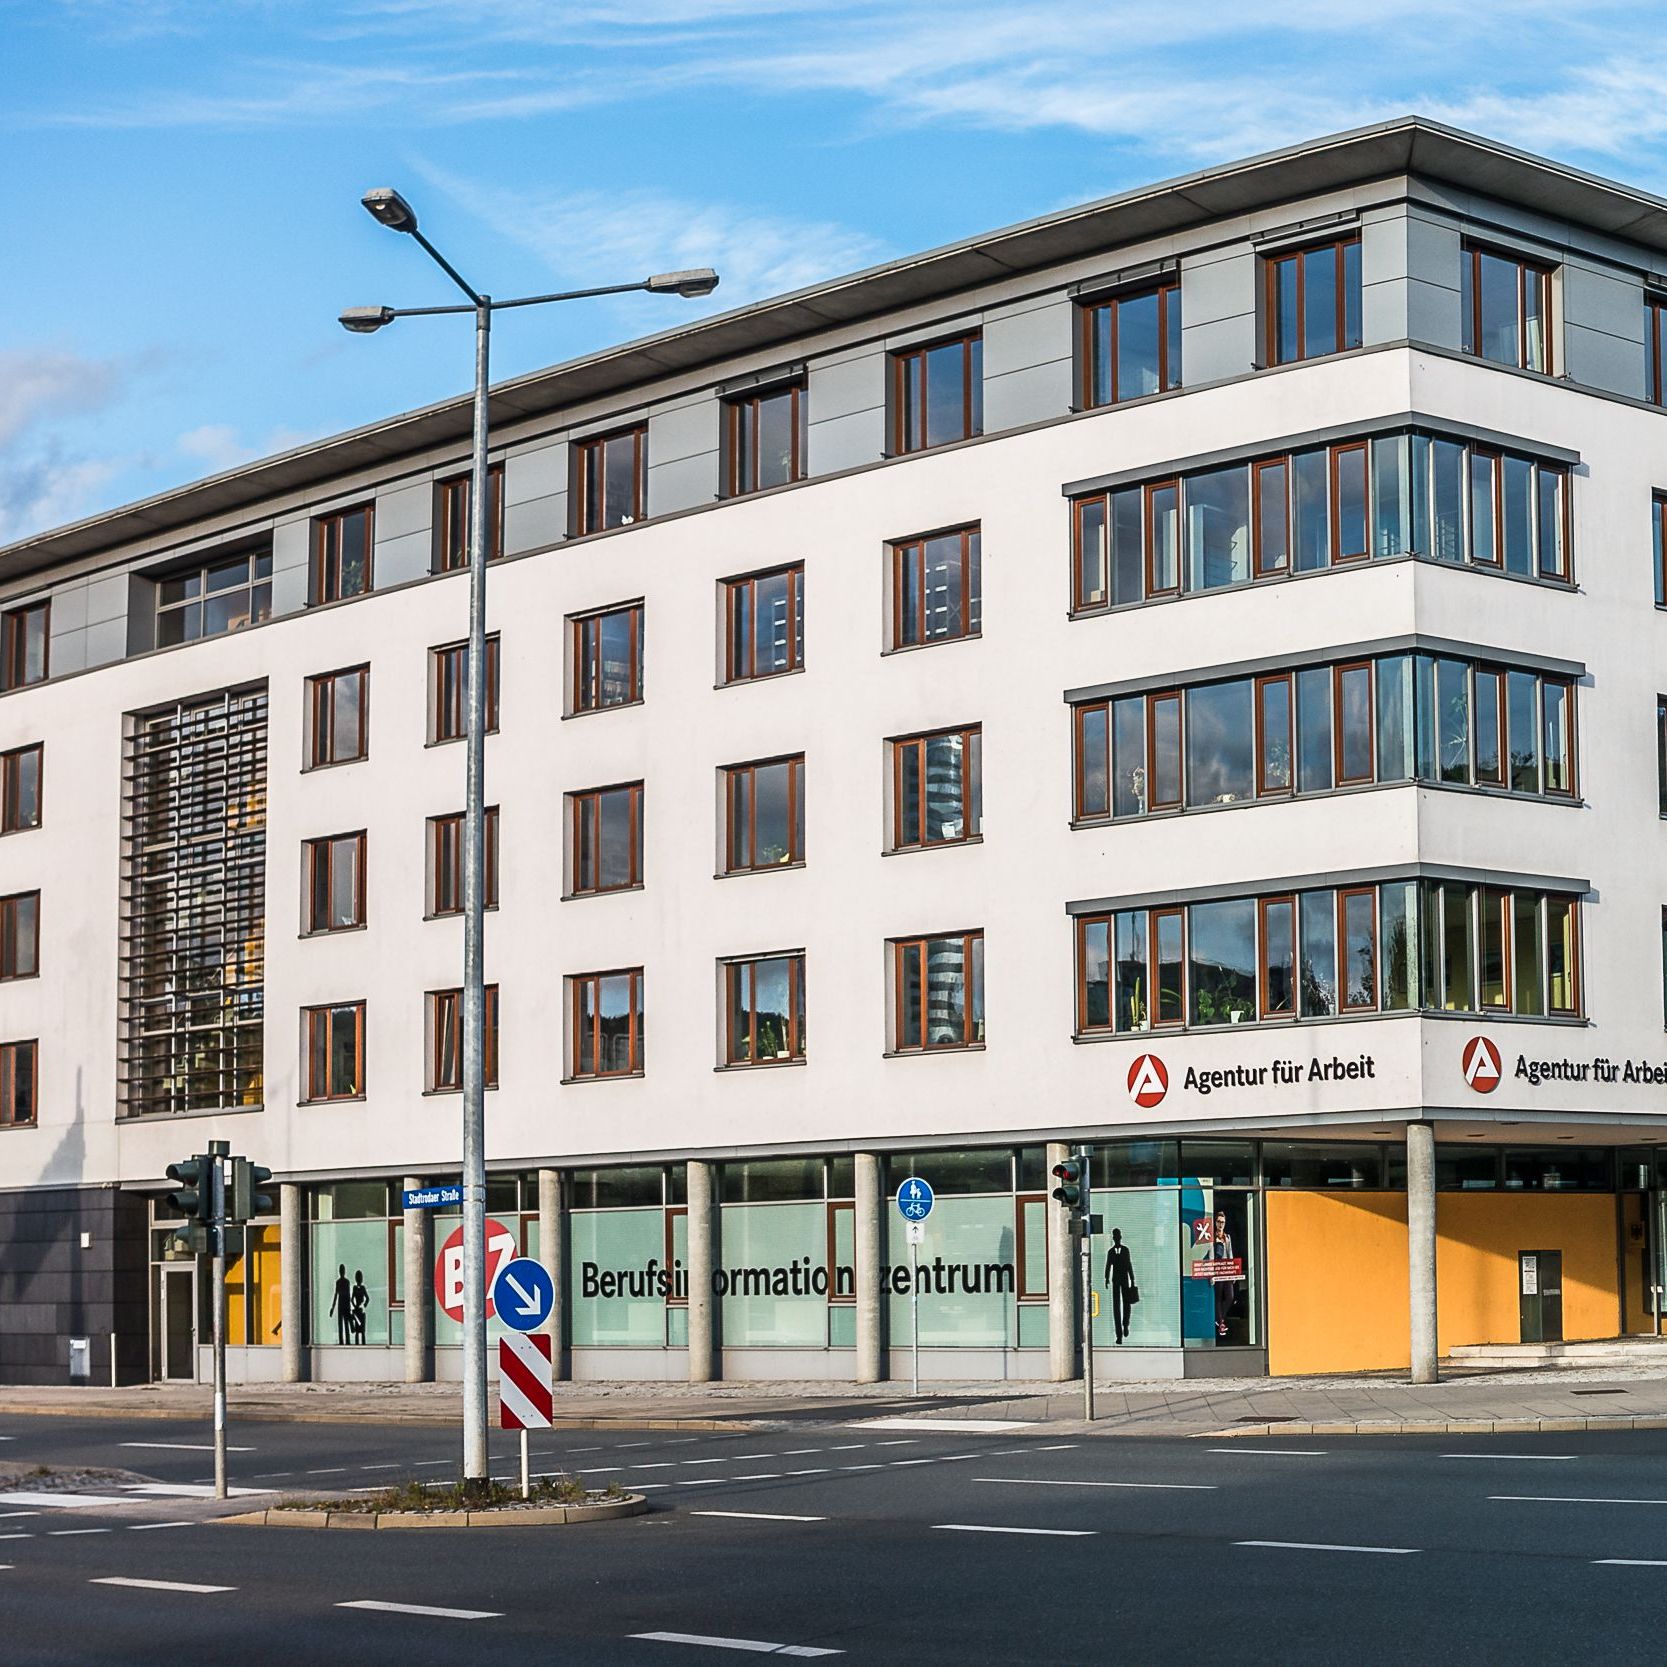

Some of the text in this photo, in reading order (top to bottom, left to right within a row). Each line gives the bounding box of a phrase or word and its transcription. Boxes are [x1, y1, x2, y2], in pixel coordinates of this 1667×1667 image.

[1184, 1054, 1375, 1094] Agentur für Arbeit
[1515, 1055, 1590, 1086] Agentur
[1593, 1058, 1620, 1083] für
[408, 1189, 460, 1205] Stadtrodaer Straße
[582, 1256, 1014, 1299] Berufsiormationzentrum
